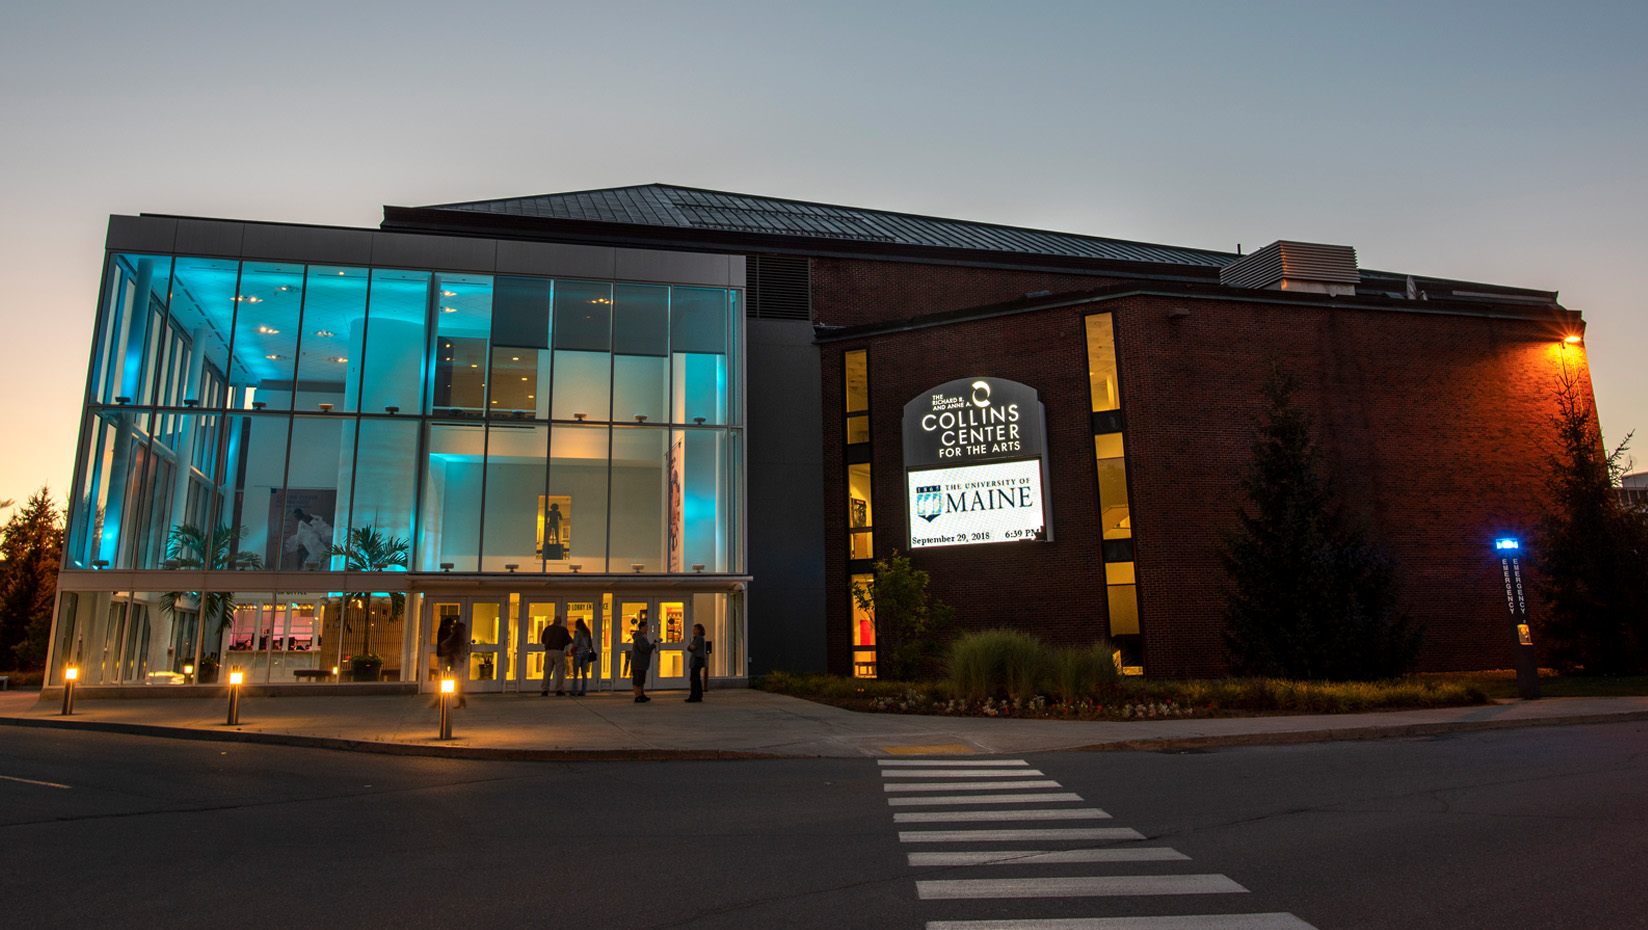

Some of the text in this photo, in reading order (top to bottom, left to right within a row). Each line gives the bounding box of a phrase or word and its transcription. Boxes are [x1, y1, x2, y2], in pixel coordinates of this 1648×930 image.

[932, 397, 958, 406] RICHARD
[947, 402, 964, 410] ANNE
[921, 404, 1019, 432] COLLINS
[941, 424, 1020, 447] CENTER
[939, 441, 1021, 458] FOR THE ARTS
[965, 479, 1016, 489] UNIVERSITY
[1019, 477, 1031, 485] OF
[945, 486, 1034, 514] MAINE
[912, 535, 955, 546] September
[957, 533, 969, 543] 29,
[971, 532, 990, 541] 2018
[1005, 529, 1023, 539] 6:39
[1502, 558, 1515, 615] EMERGENCY
[1512, 558, 1526, 615] EMERGENCY
